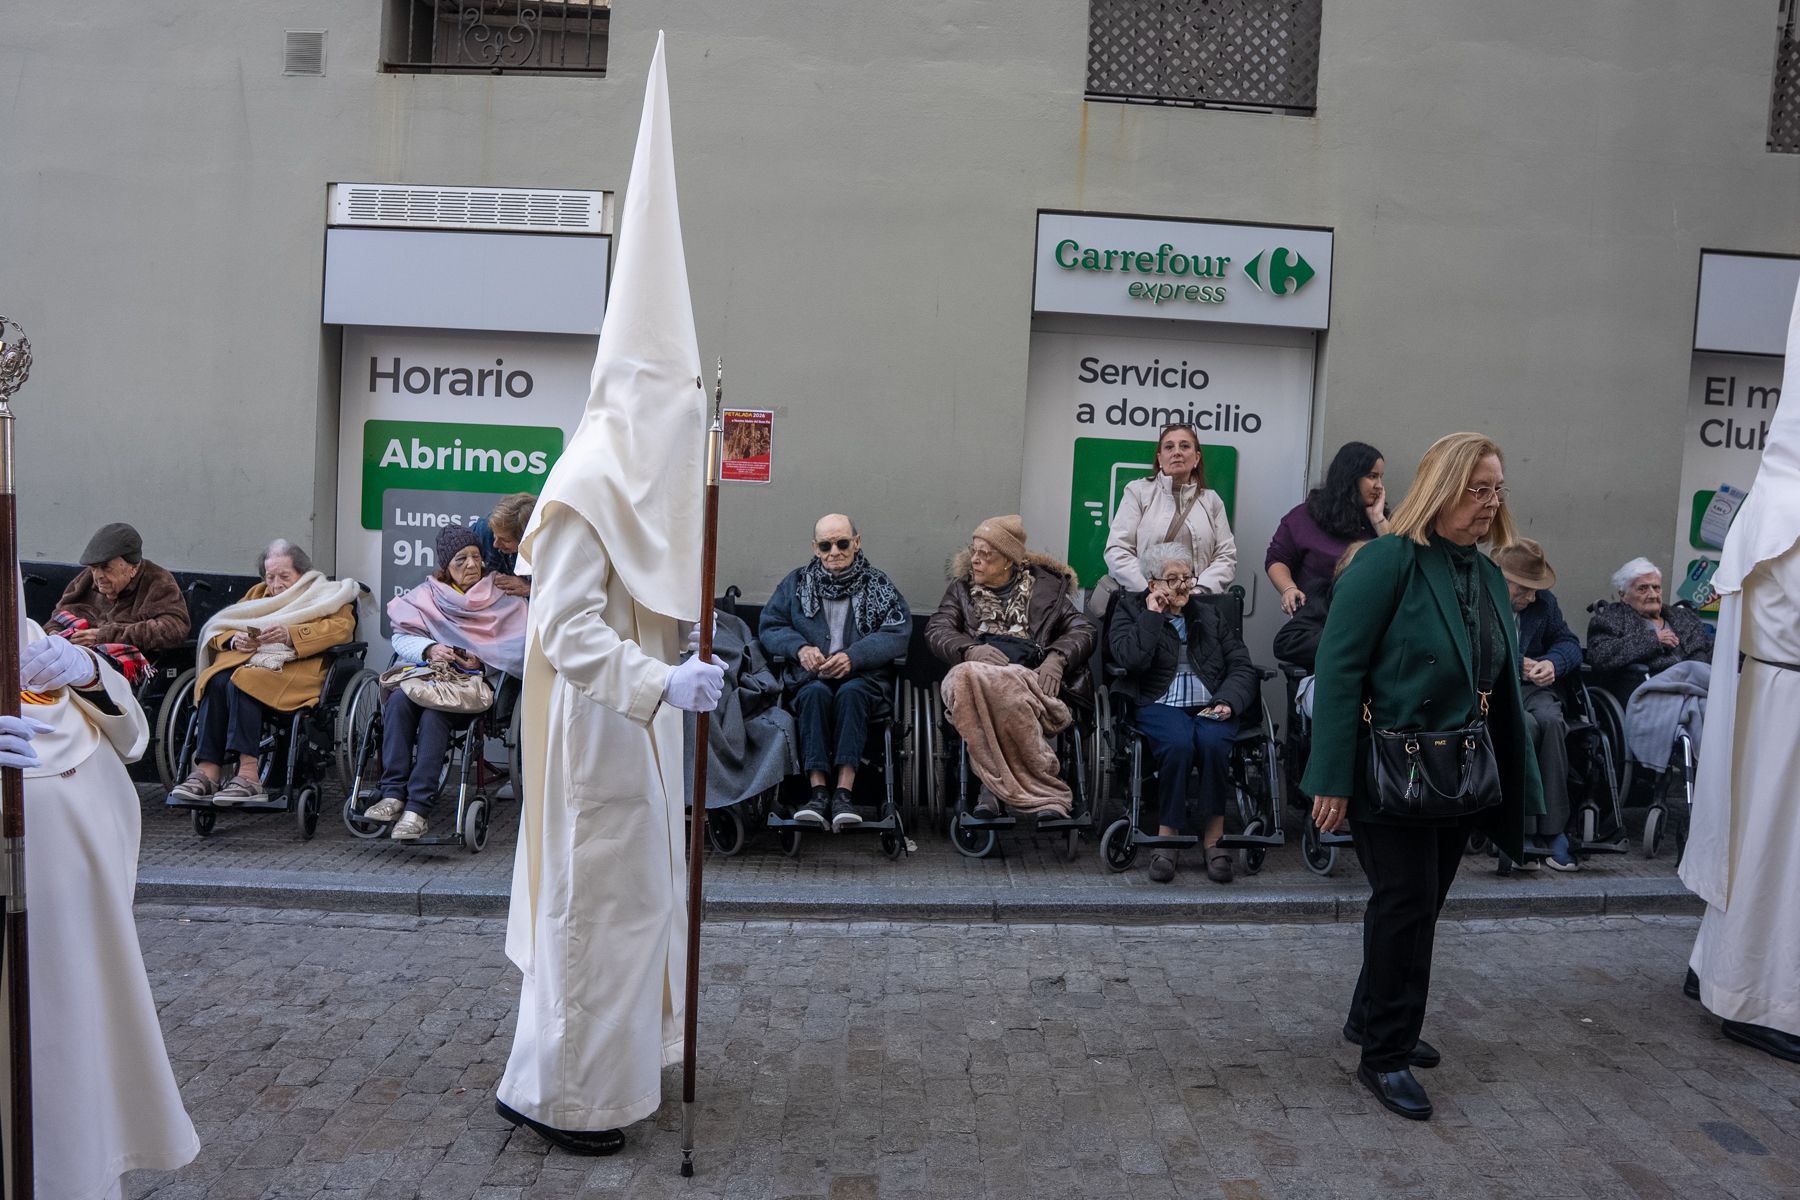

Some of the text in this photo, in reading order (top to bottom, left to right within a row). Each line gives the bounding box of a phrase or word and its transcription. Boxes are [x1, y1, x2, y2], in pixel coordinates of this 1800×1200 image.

[1055, 239, 1231, 279] Carrefour
[1127, 280, 1227, 304] express
[368, 356, 534, 399] Horario
[1078, 357, 1210, 390] Servicio
[1704, 376, 1736, 408] El
[1075, 398, 1262, 434] a domicilio
[379, 438, 548, 475] Abrimos
[395, 508, 462, 528] Lunes
[393, 539, 434, 567] 9h
